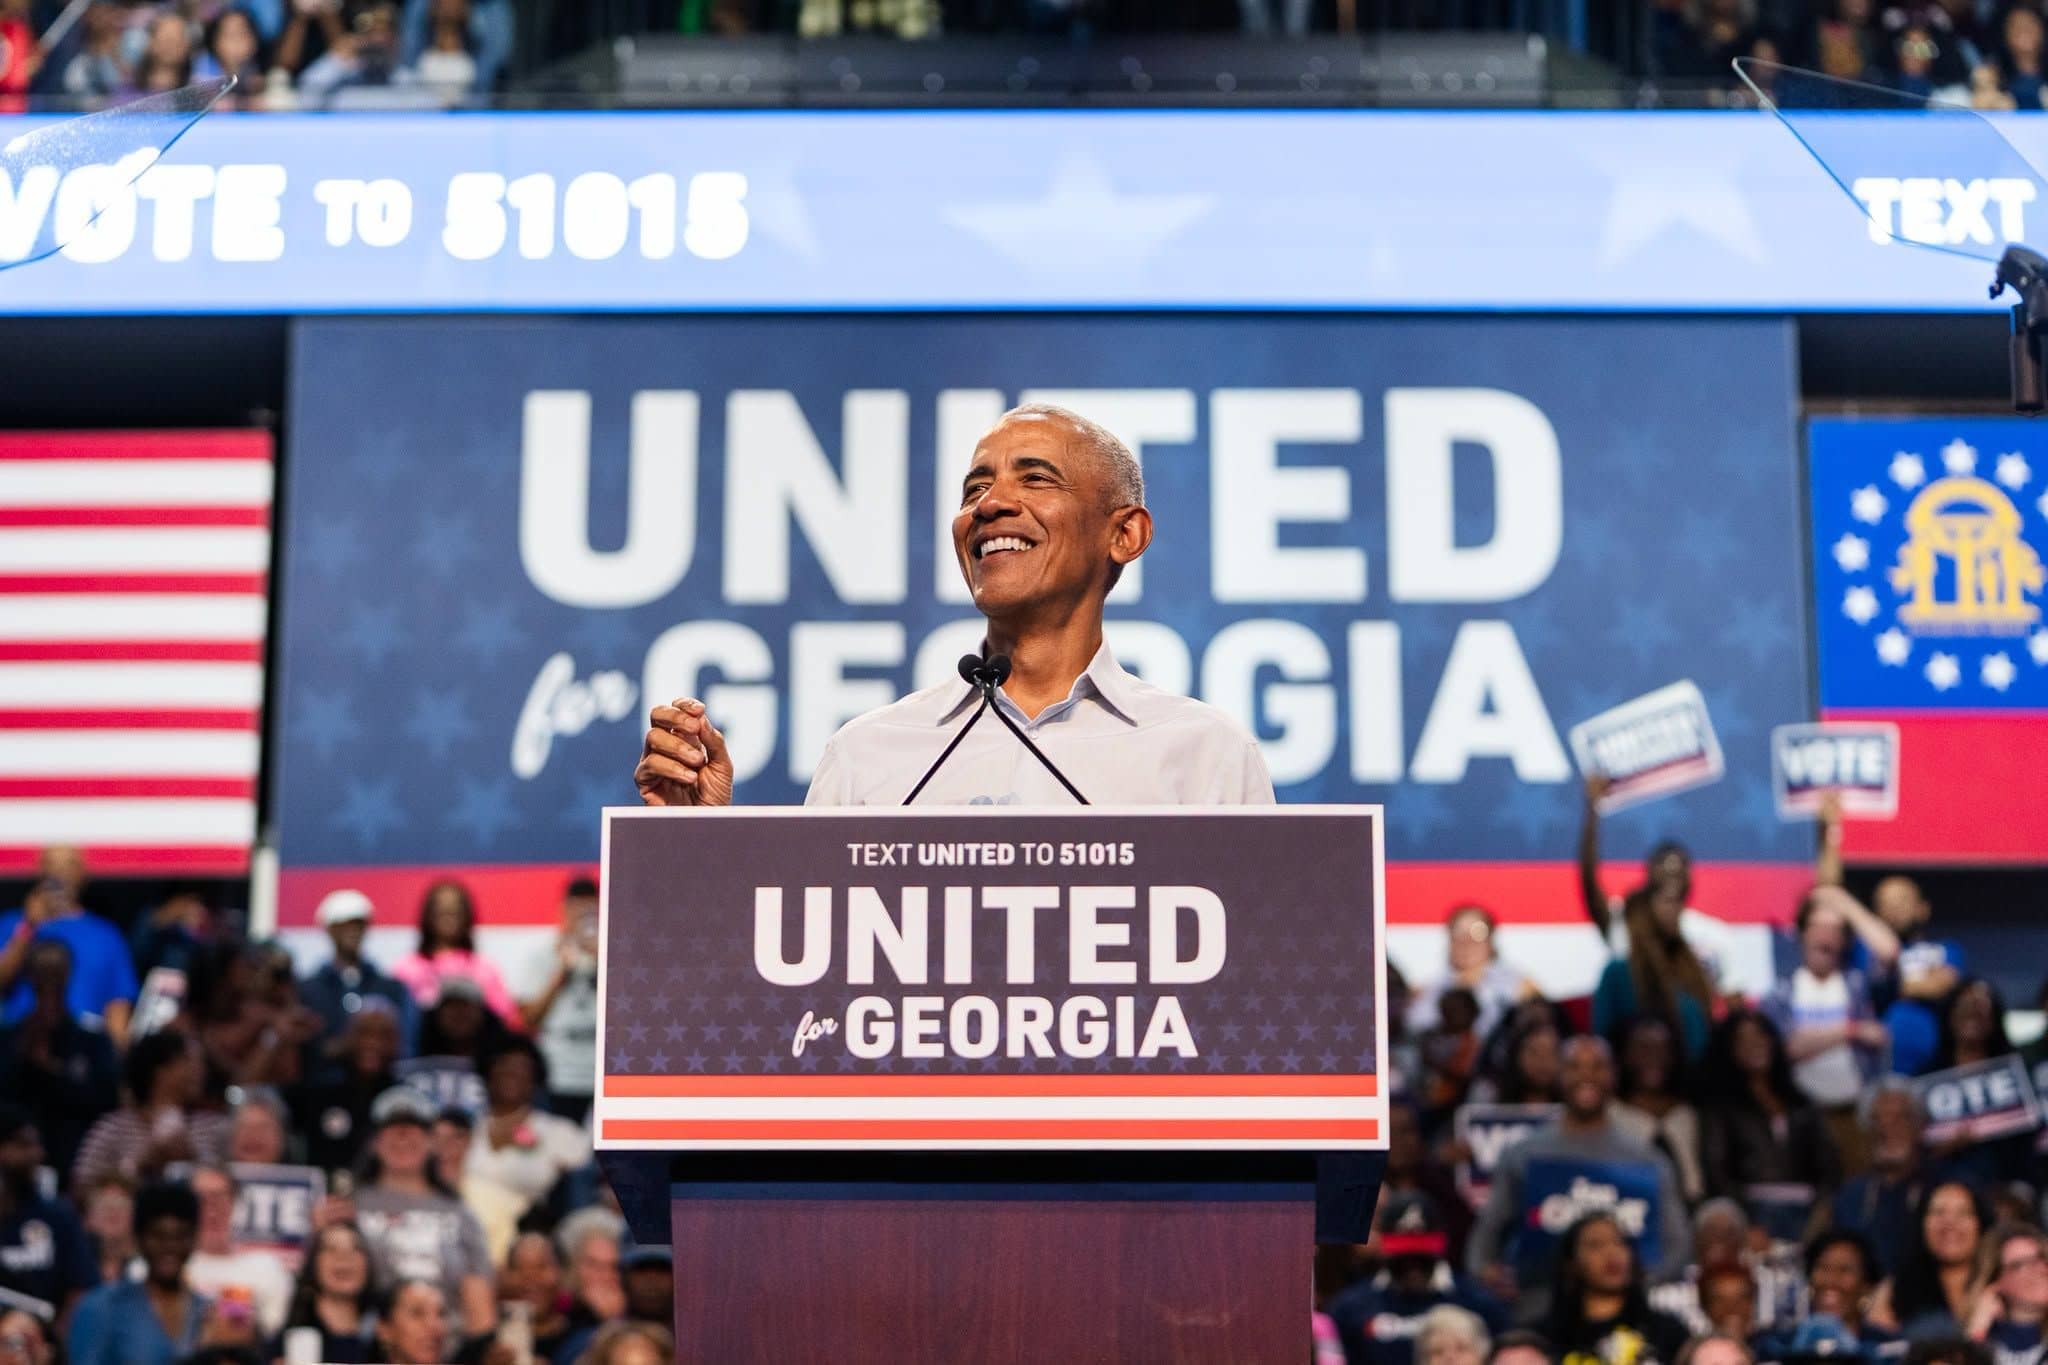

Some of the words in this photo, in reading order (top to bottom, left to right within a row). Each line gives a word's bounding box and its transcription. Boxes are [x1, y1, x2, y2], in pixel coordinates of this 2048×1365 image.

[0, 164, 287, 262] VOTE
[313, 178, 413, 247] TO
[442, 172, 749, 260] 51015
[1853, 177, 2037, 245] TEXT
[642, 618, 1573, 787] GEGIA
[1781, 737, 1884, 786] VOTE
[847, 843, 913, 866] TEXT
[917, 843, 1015, 866] UNITED
[1020, 843, 1054, 866] TO
[1059, 842, 1136, 866] 51015
[754, 885, 1227, 986] UNITED
[791, 1010, 839, 1058] for
[845, 995, 1199, 1059] GEORGIA
[1926, 1068, 2018, 1121] OTE
